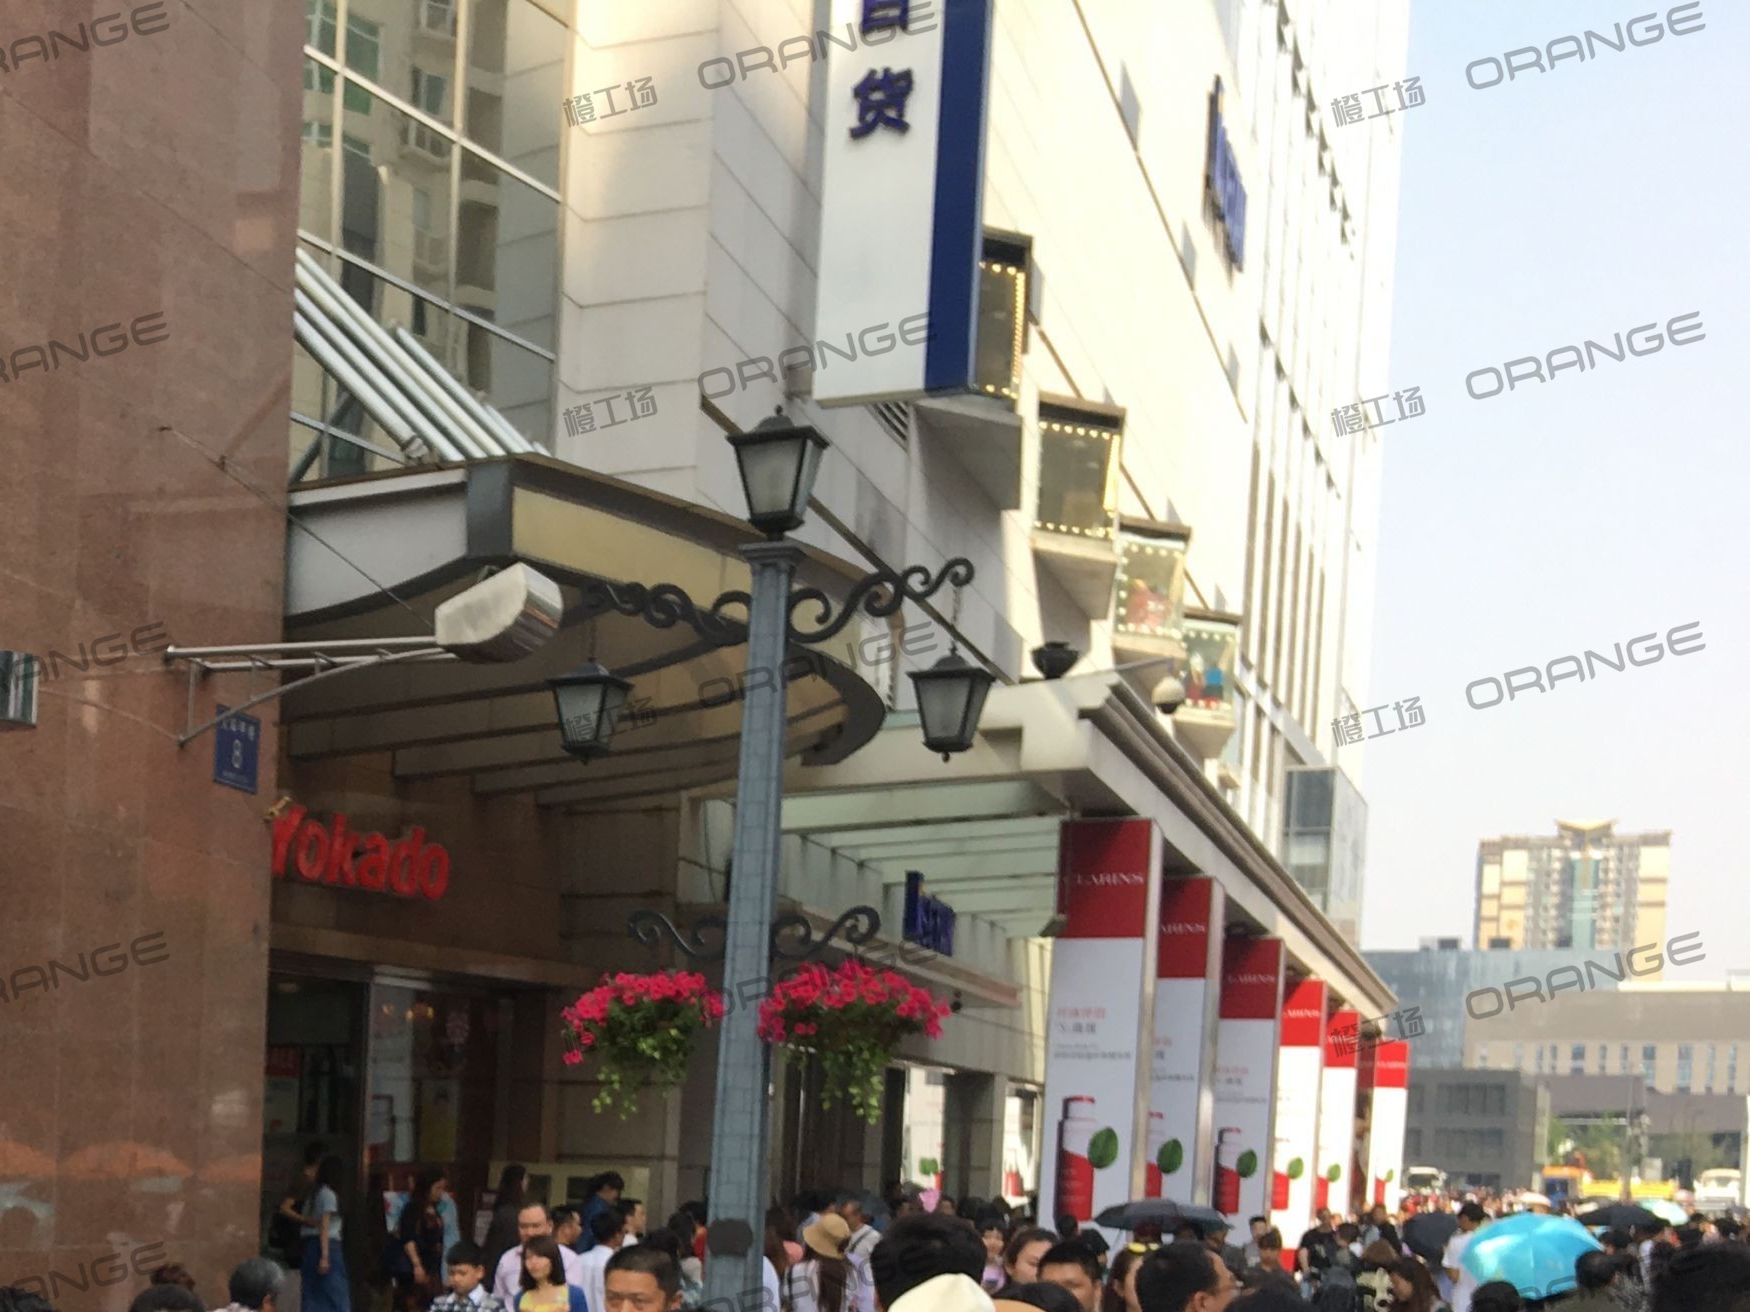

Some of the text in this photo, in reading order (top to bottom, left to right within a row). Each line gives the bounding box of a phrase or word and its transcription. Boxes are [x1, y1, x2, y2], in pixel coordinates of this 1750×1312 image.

[232, 739, 243, 769] 8
[272, 803, 450, 900] Yokado
[1064, 872, 1145, 886] LARINS
